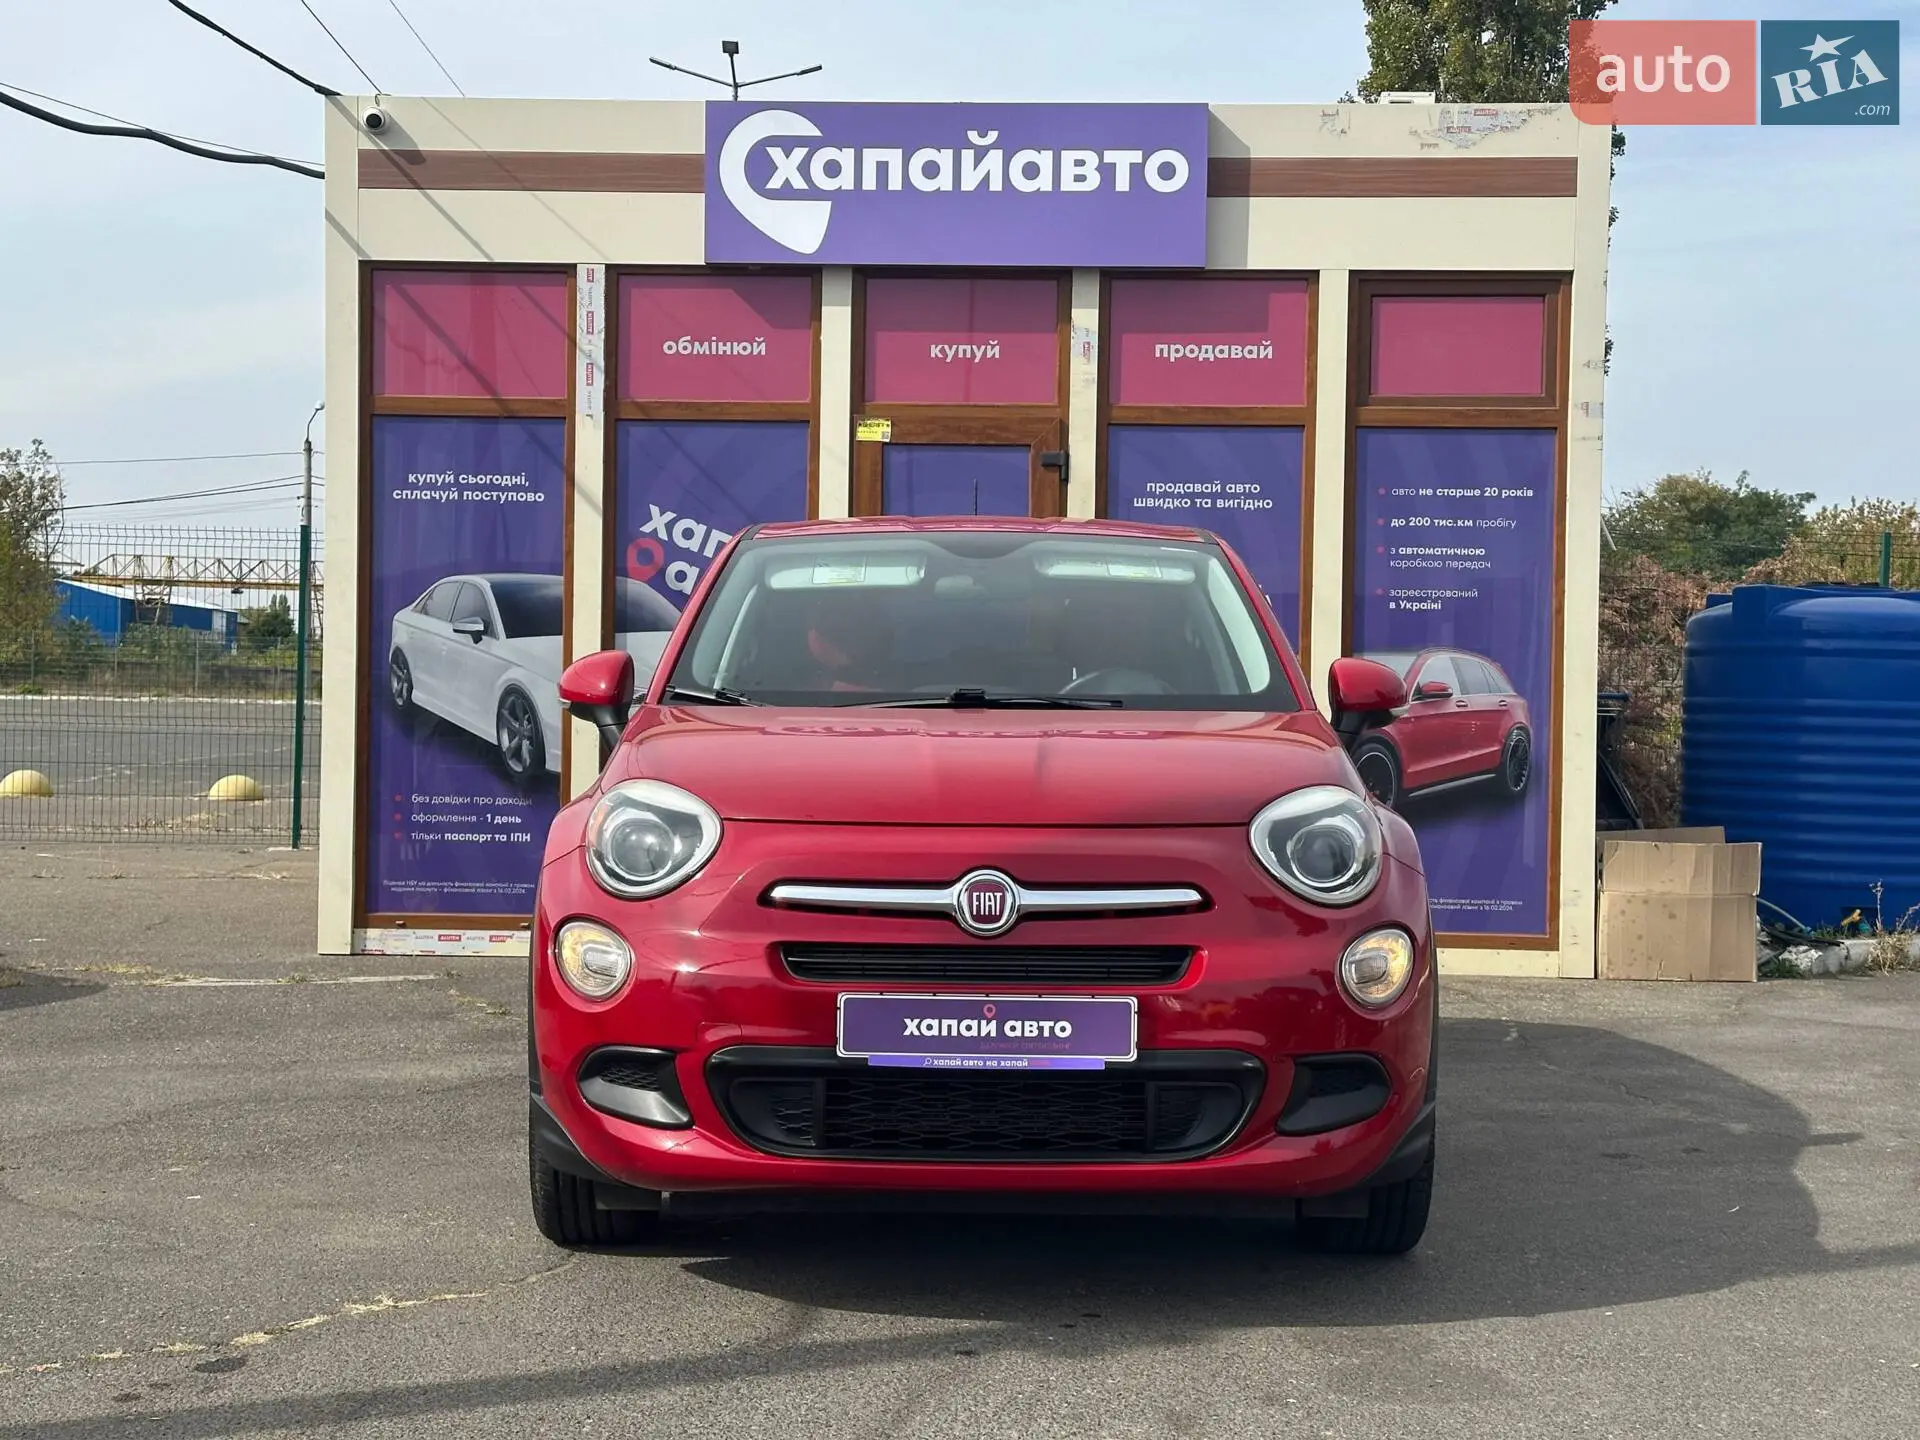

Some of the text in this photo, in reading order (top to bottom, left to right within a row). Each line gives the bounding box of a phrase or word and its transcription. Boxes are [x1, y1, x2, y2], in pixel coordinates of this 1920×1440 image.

[765, 130, 1189, 193] хапайавто
[662, 336, 766, 357] обмінюй
[930, 340, 1000, 363] купуй
[1154, 340, 1274, 363] продавай
[408, 471, 530, 487] купуй сьогодні,
[392, 487, 545, 503] сплачуй поступово
[1146, 481, 1261, 495] продавай авто
[1391, 486, 1534, 499] авто не старше 20 років
[1133, 496, 1273, 510] швидко та вигідно
[1390, 516, 1517, 530] до 200 тис.км пробігу
[1390, 546, 1486, 556] з автоматичною
[1389, 558, 1491, 571] коробкою передач
[1389, 587, 1479, 598] зареєстрований
[1389, 600, 1442, 611] в Україні
[411, 793, 430, 804] без
[432, 793, 471, 805] довідки
[473, 796, 493, 806] про
[411, 813, 476, 824] оформлення
[486, 814, 492, 823] 1
[494, 815, 522, 824] день
[411, 832, 531, 843] тільки паспорт та ІПН
[973, 892, 1003, 915] FIAT
[1004, 1020, 1072, 1038] авто
[933, 1058, 962, 1068] хапай
[963, 1059, 983, 1067] авто
[986, 1059, 998, 1067] на
[1000, 1058, 1028, 1067] хапай
